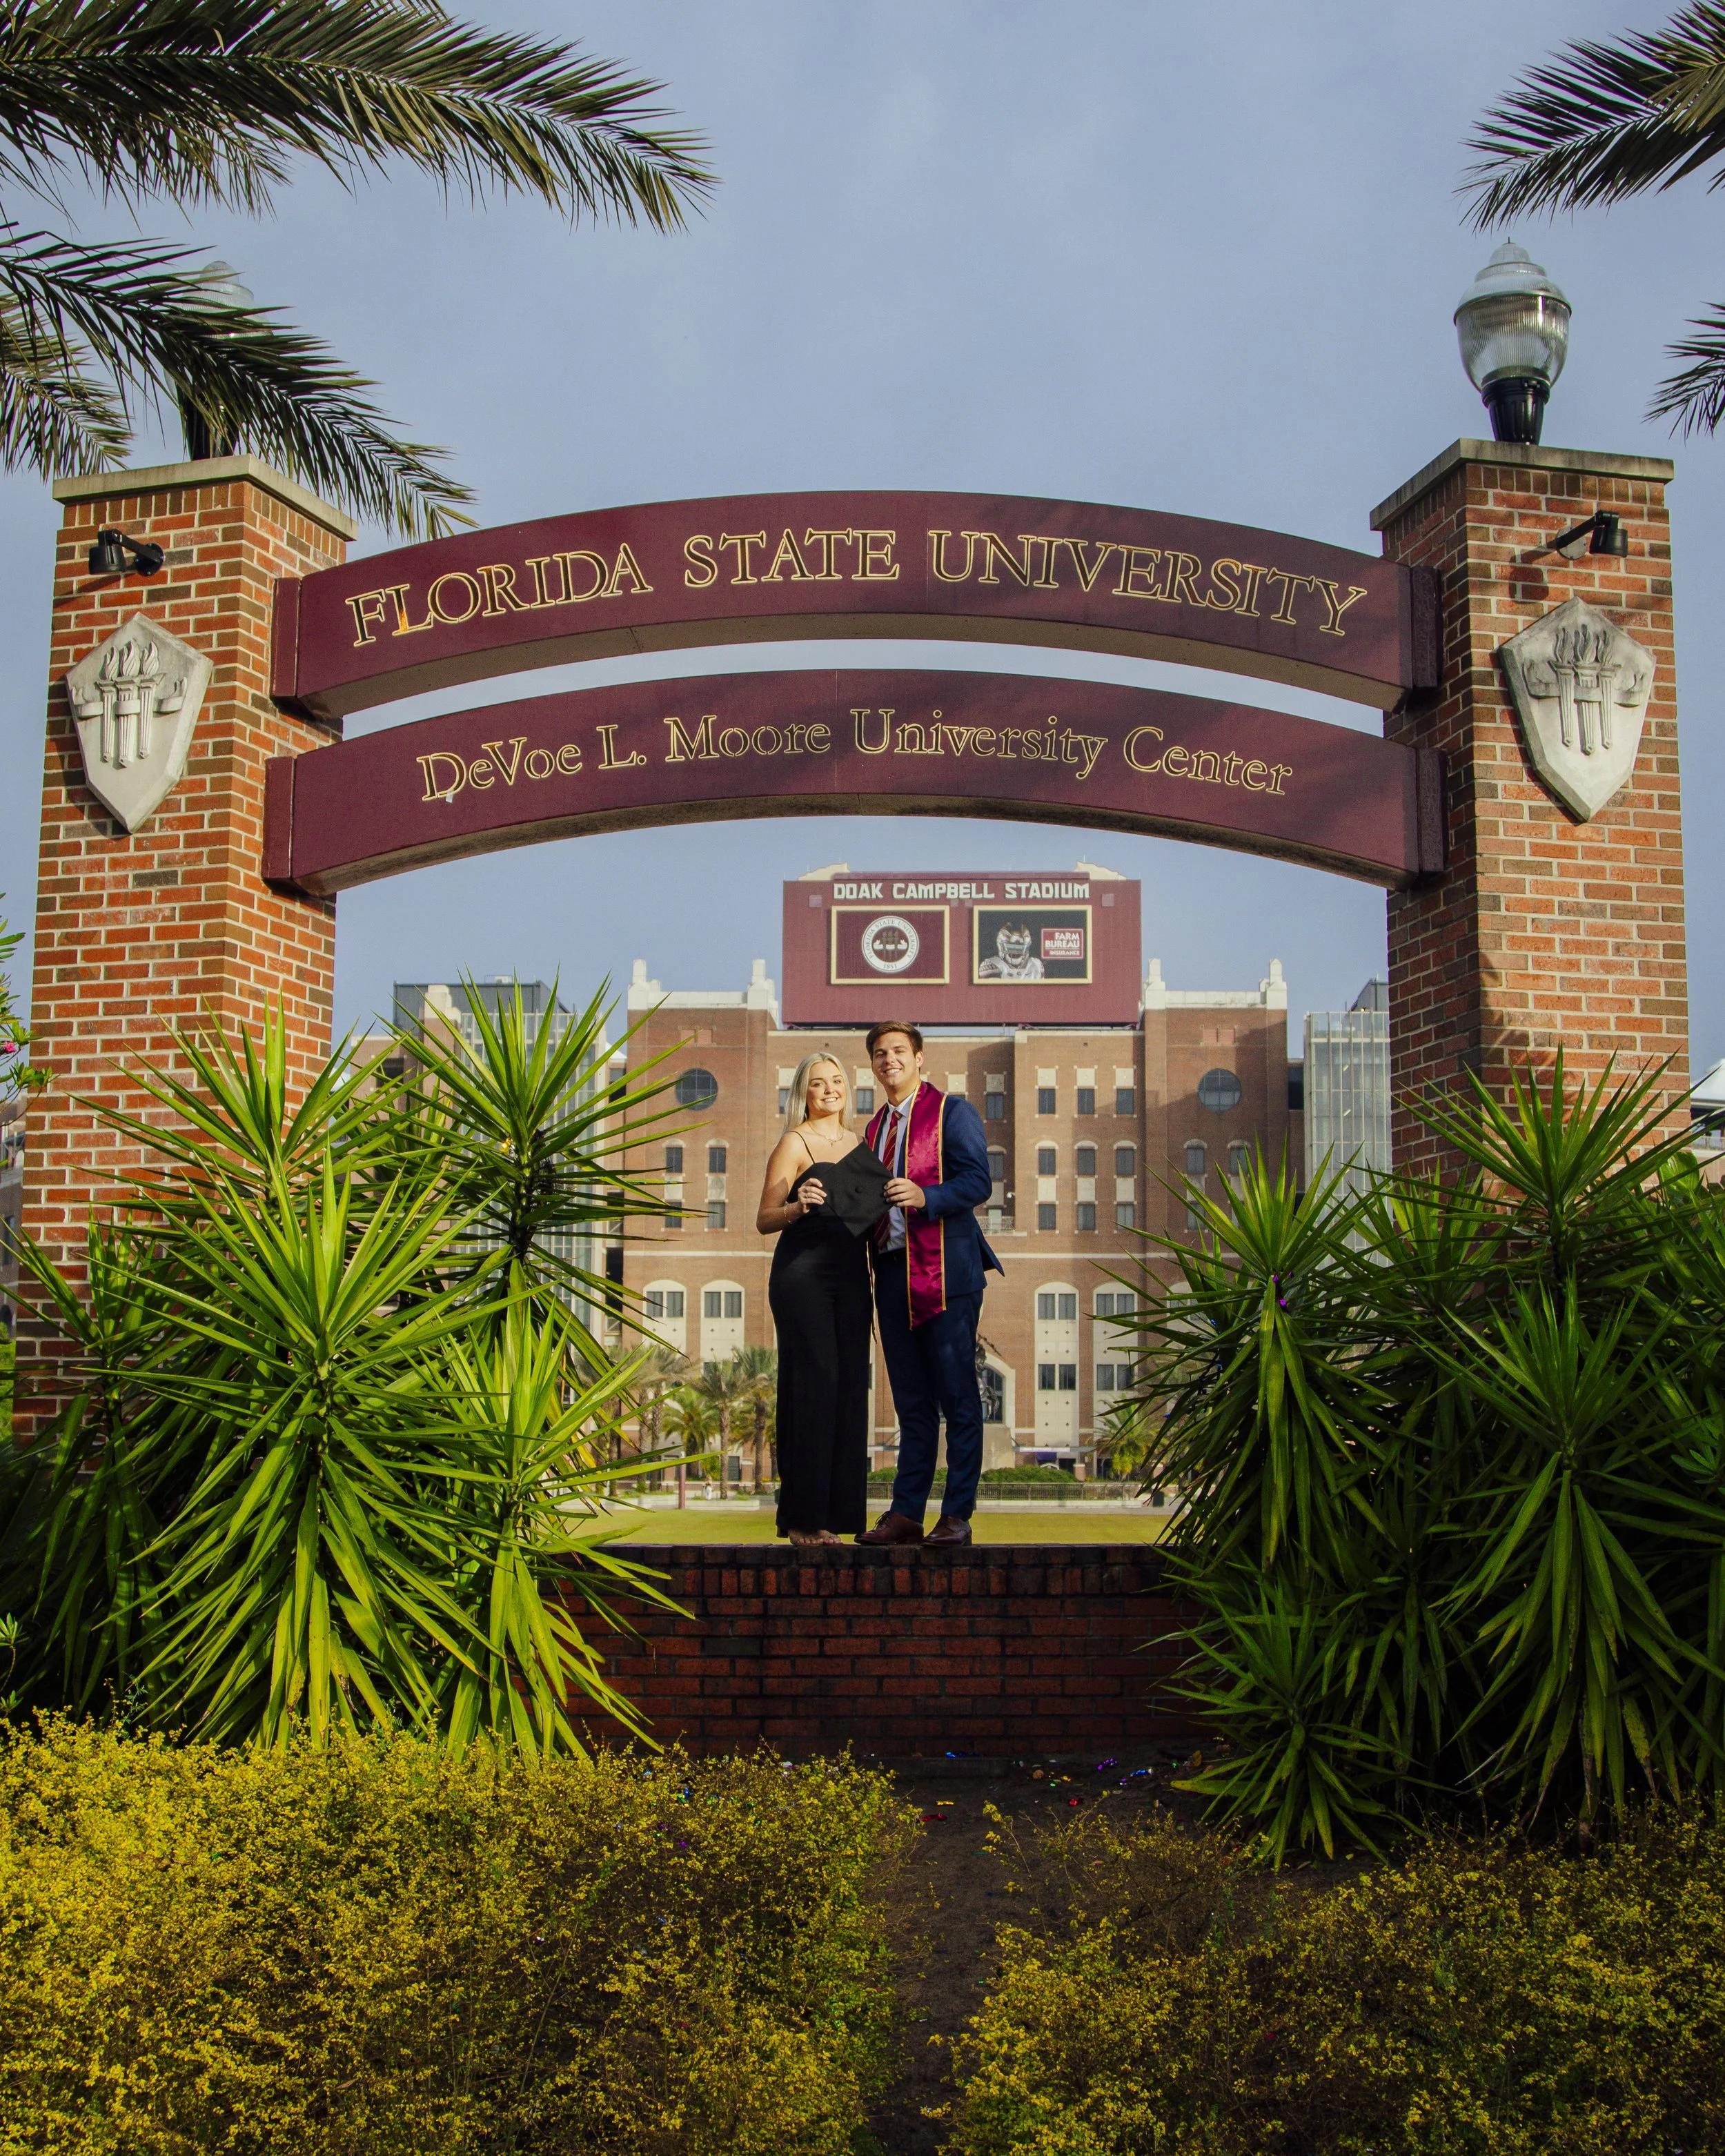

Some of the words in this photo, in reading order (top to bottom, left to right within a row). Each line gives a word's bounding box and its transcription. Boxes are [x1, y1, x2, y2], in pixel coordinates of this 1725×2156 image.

[345, 542, 653, 646] FLORIDA
[684, 527, 900, 588] STATE
[928, 529, 1368, 635] UNIVERSITY
[416, 736, 583, 802] DeVoe
[596, 724, 647, 769] L.
[663, 714, 831, 762] Moore
[850, 708, 1109, 779] University
[1123, 726, 1293, 795] Center
[834, 882, 884, 899] DOAK
[893, 882, 995, 899] CAMPBELL
[1005, 882, 1090, 899] STADIUM
[865, 927, 876, 959] FLORIDA
[875, 919, 896, 929] STATE
[898, 919, 916, 960] UNIVERSITY
[1045, 940, 1080, 948] BUREAU
[1054, 932, 1080, 940] FARM
